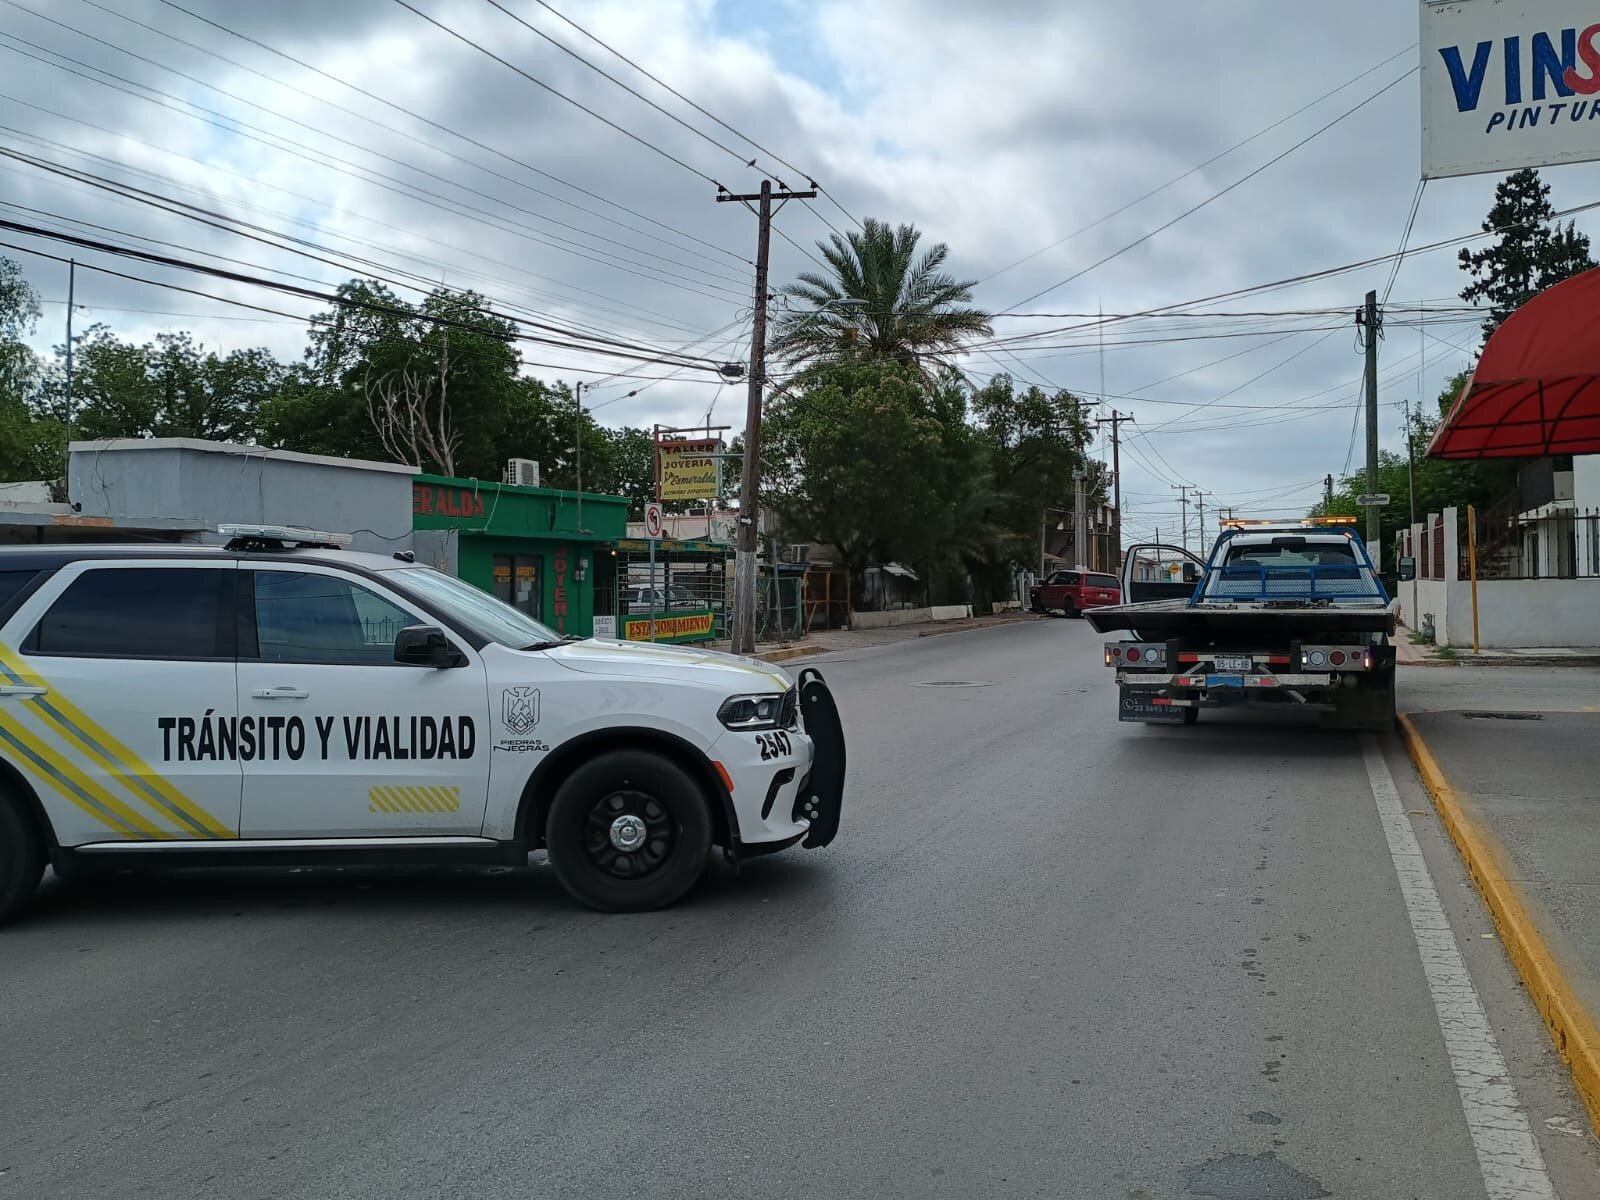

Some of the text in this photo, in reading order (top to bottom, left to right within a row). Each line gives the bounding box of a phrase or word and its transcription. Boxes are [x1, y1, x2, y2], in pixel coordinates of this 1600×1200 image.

[670, 471, 716, 486] Esmeralda
[158, 708, 476, 761] TRÁNSITO Y VIALIDAD
[755, 731, 792, 761] 2547
